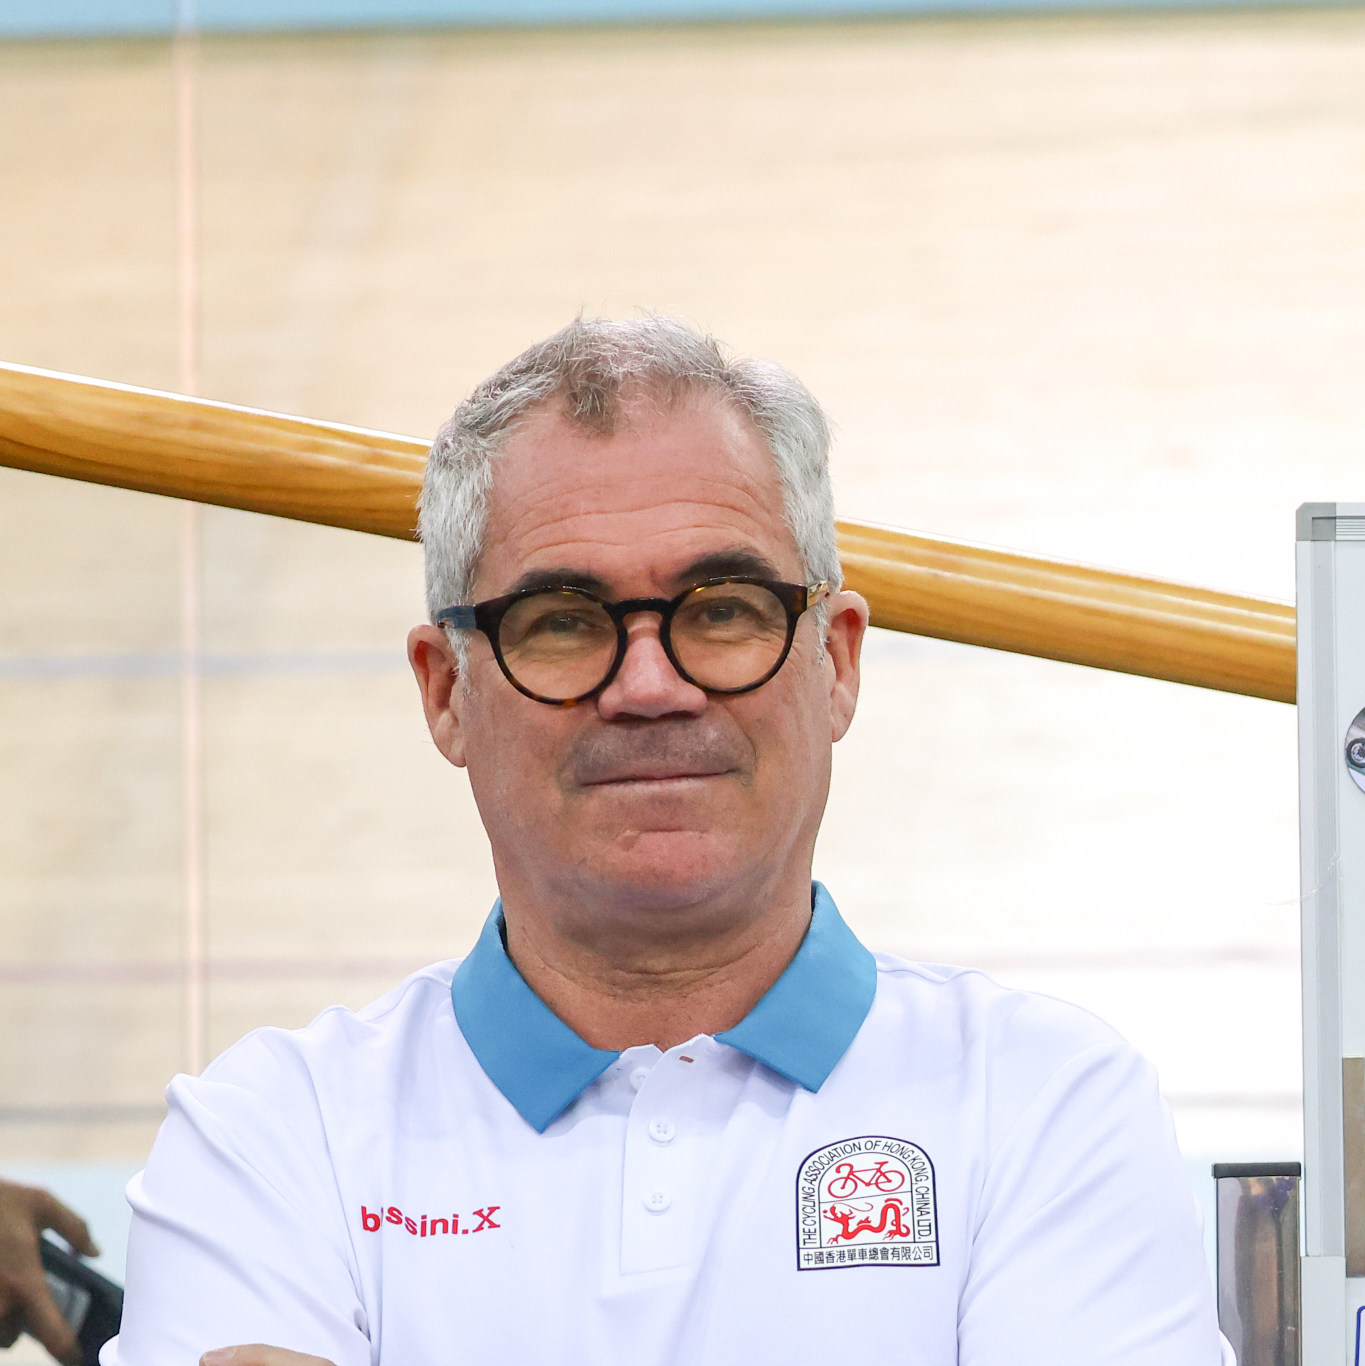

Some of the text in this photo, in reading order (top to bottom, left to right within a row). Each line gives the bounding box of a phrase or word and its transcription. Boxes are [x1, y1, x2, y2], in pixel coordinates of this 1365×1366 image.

[864, 1140, 882, 1151] OF
[882, 1140, 915, 1162] HONG
[803, 1142, 861, 1186] ASSOCIATION
[801, 1185, 817, 1226] CYCLING
[915, 1185, 932, 1217] CHINA
[361, 1205, 501, 1237] bssini.X
[917, 1218, 932, 1239] LTD.
[802, 1227, 817, 1246] THE
[803, 1246, 933, 1265] 中國香港單車總會有限公司
